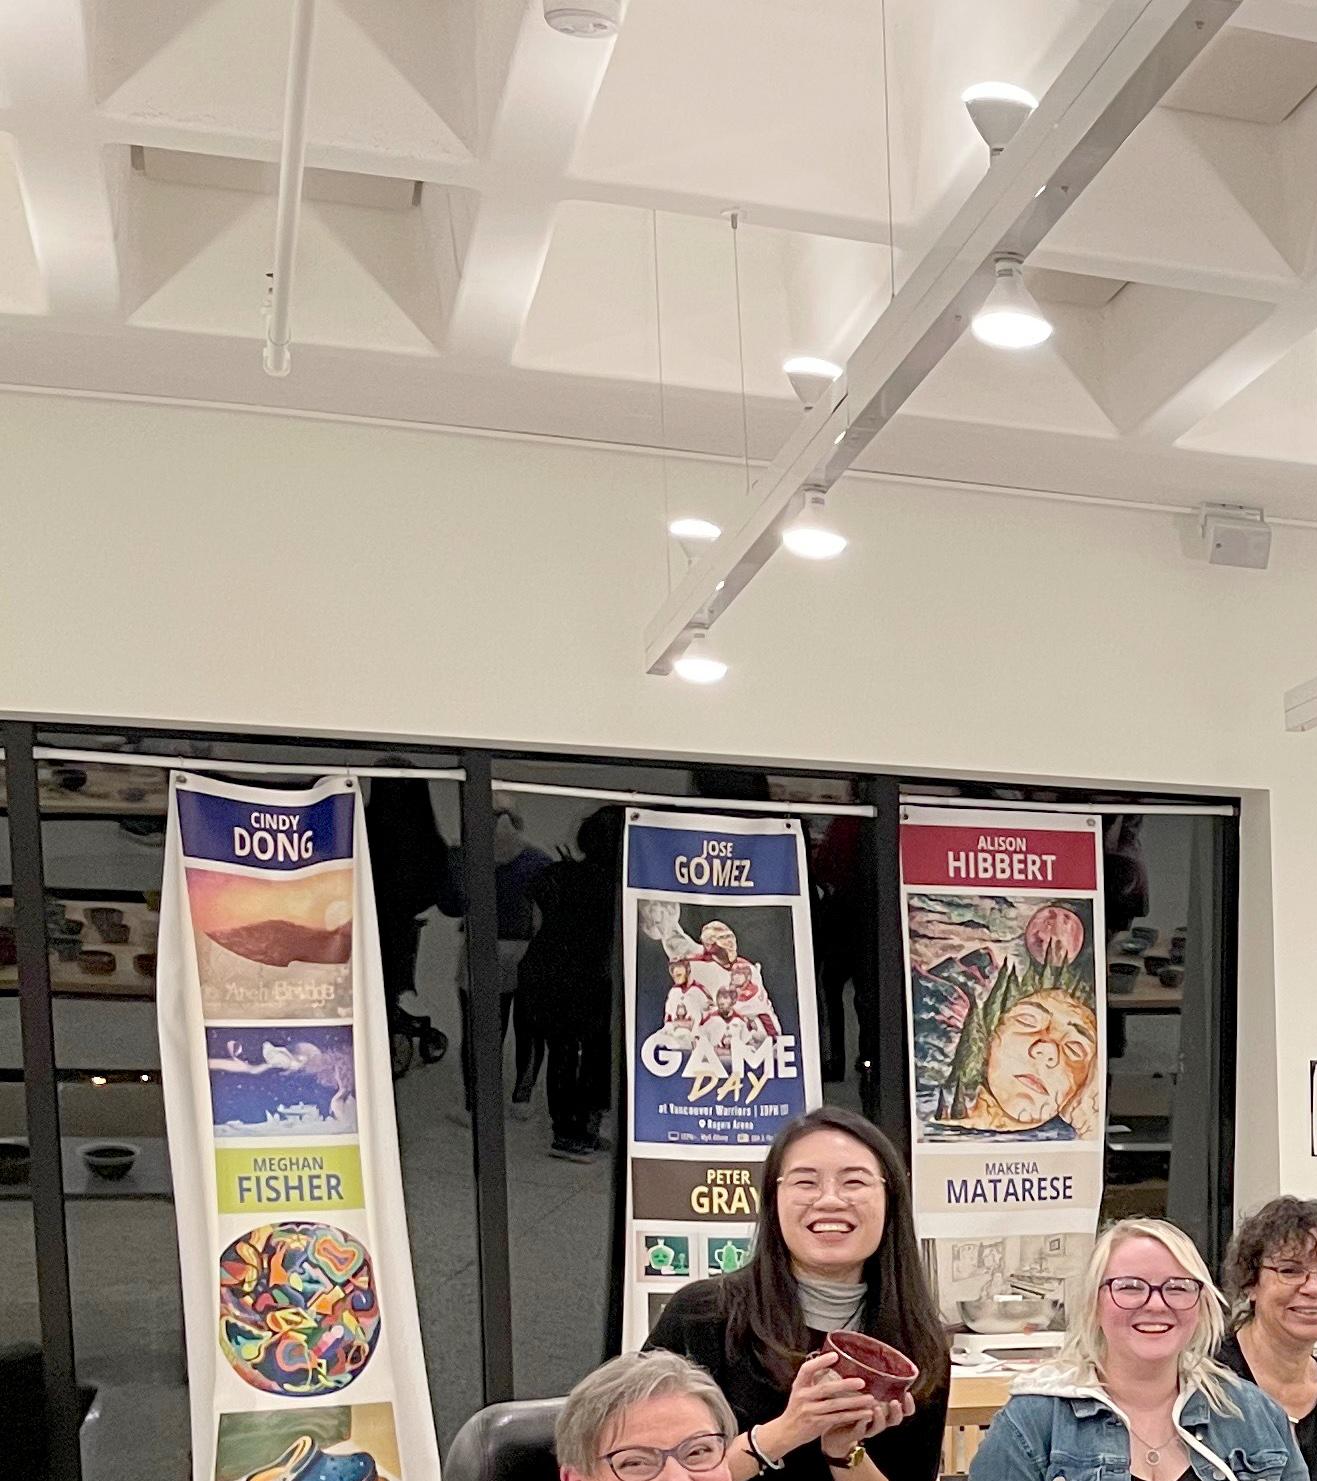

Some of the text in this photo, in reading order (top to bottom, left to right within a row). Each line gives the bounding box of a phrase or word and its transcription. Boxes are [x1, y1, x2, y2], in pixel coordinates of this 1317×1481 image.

[251, 812, 299, 830] CINDY
[234, 827, 313, 862] DONG
[700, 840, 734, 858] JOSE
[978, 835, 1026, 851] ALISON
[675, 856, 754, 887] GOMEZ
[947, 851, 1056, 880] HIBBERT
[641, 1032, 798, 1079] GAME
[688, 1071, 769, 1104] DAY
[669, 1103, 713, 1116] Vancouver
[715, 1104, 751, 1116] Warriors
[253, 1157, 324, 1171] MEGHAN
[985, 1162, 1039, 1175] MAKENA
[707, 1169, 750, 1184] PETER
[237, 1173, 344, 1203] FISHER
[946, 1176, 1073, 1203] MATARESE
